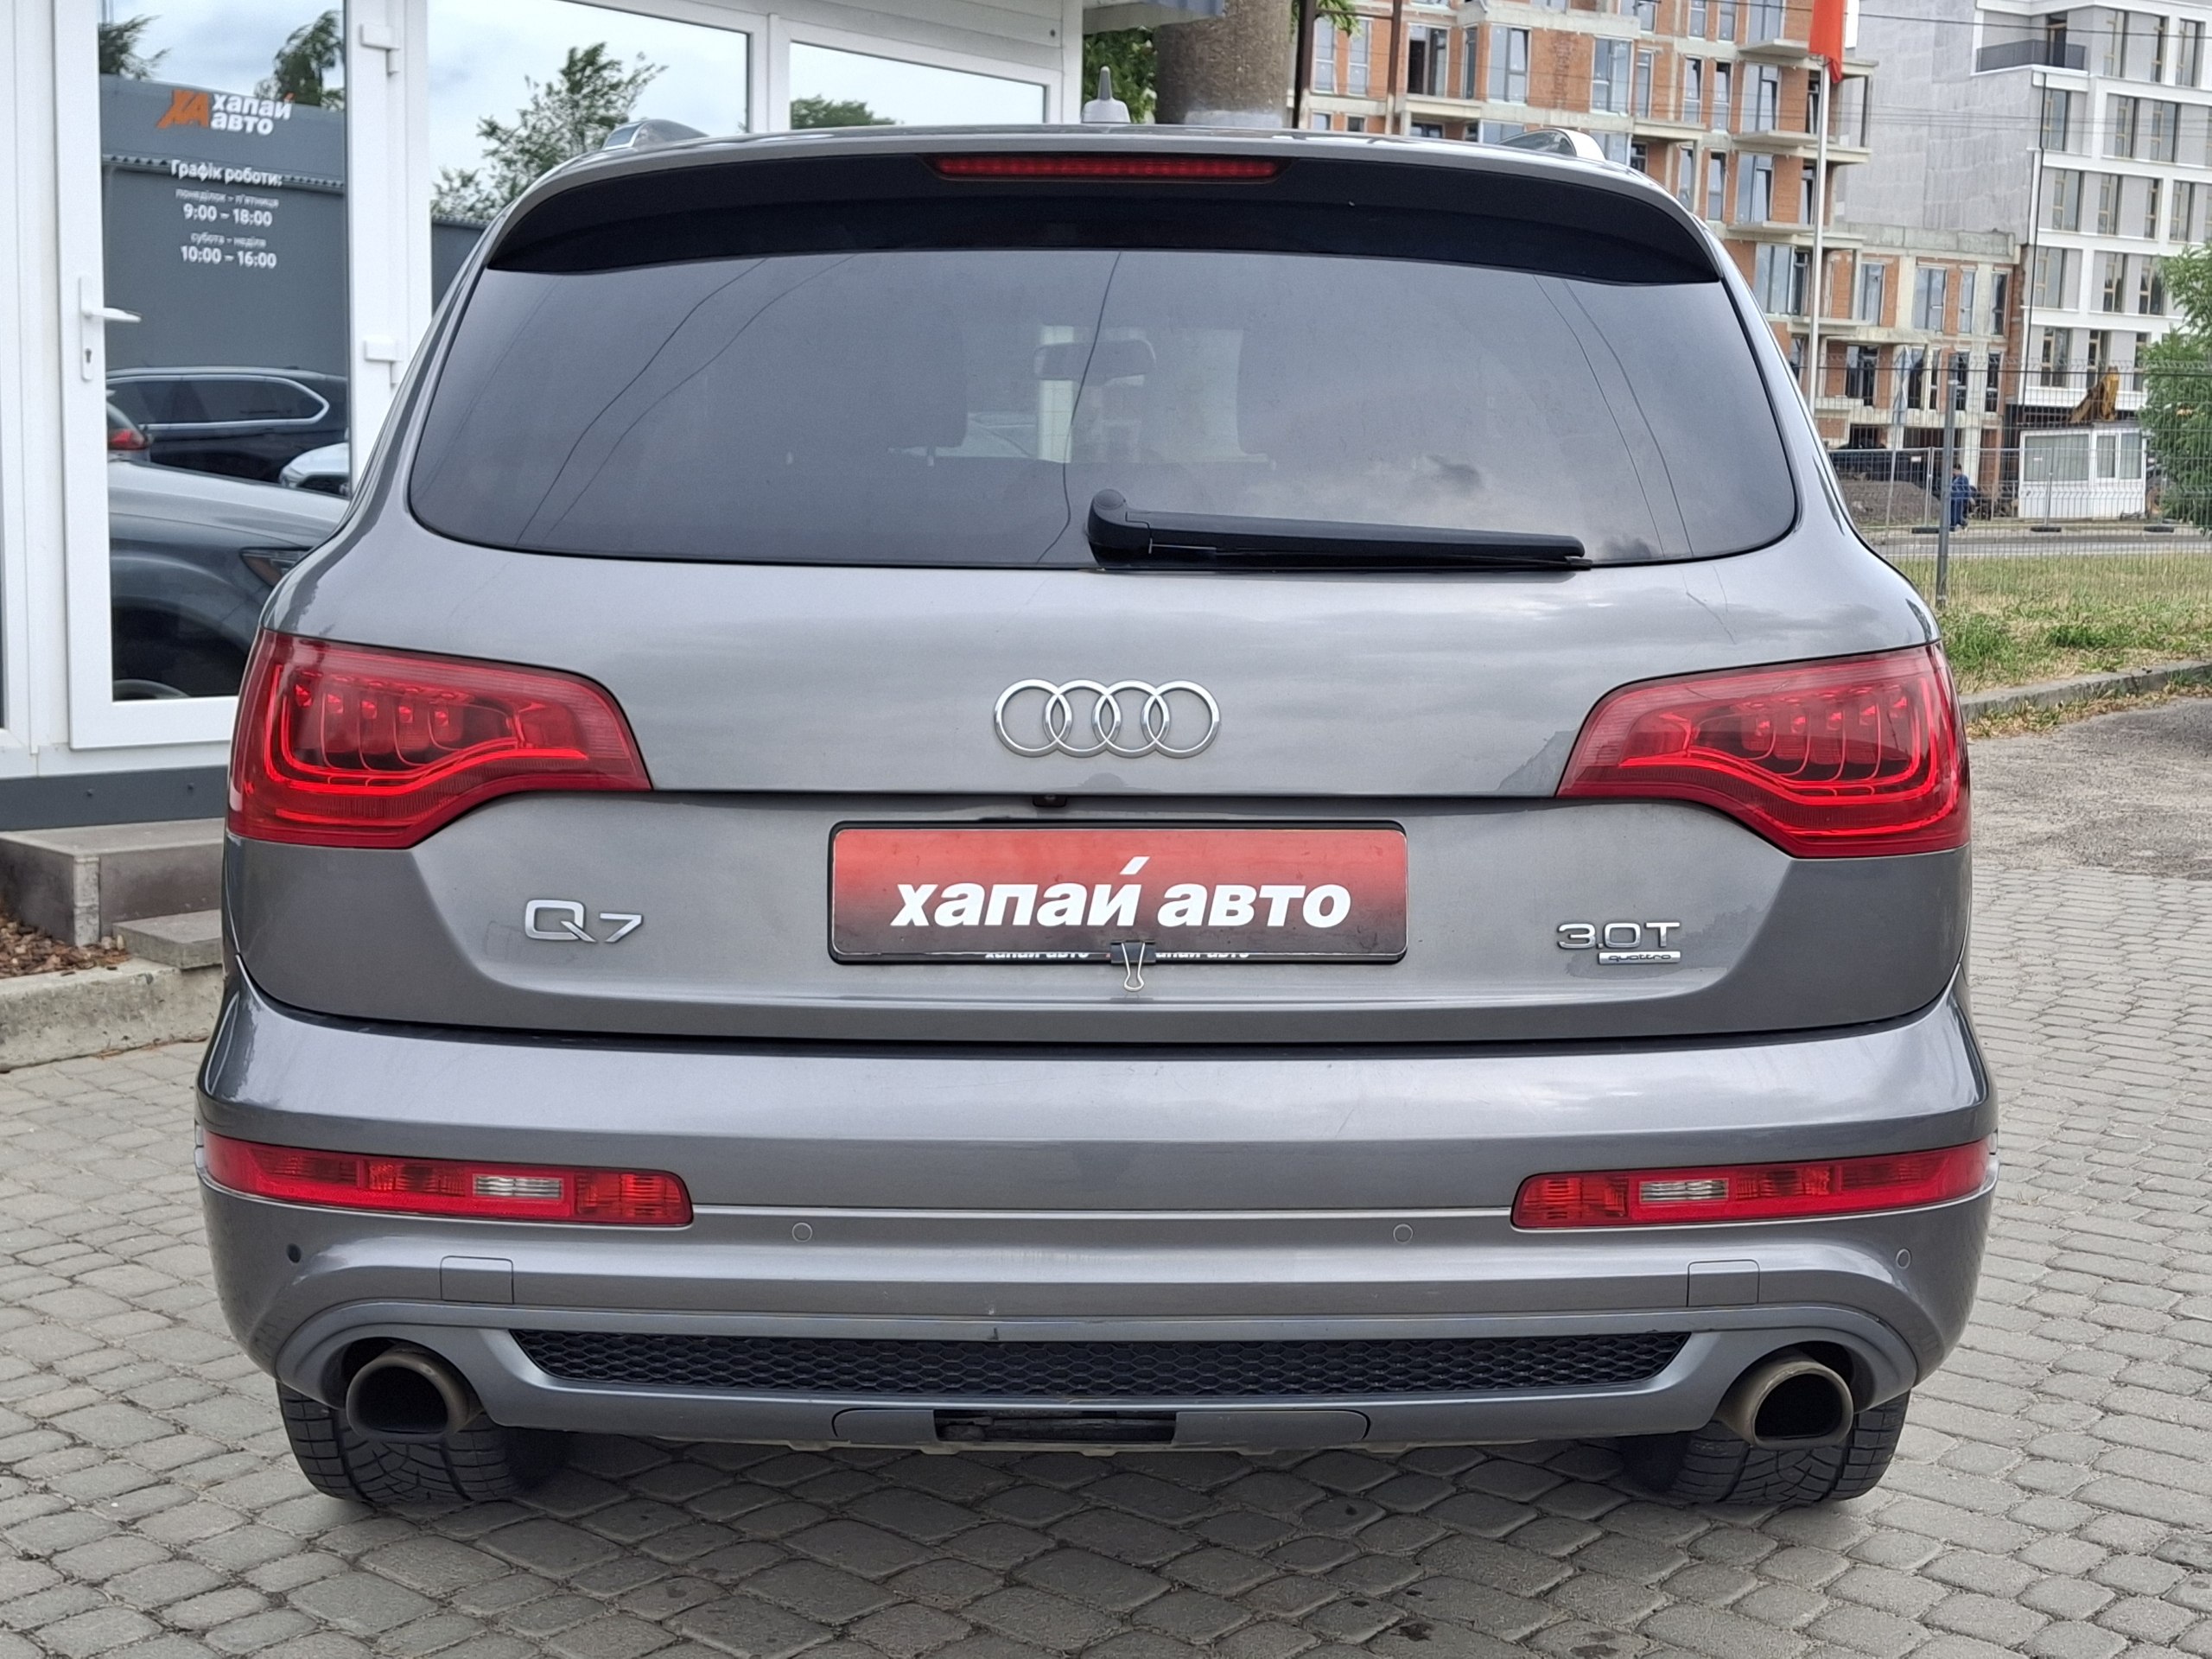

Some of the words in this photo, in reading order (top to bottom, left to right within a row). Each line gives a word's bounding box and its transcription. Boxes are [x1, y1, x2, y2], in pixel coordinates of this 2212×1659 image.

[212, 92, 294, 120] хапай
[210, 111, 274, 135] авто
[171, 159, 221, 181] Графік
[224, 167, 283, 187] роботи:
[183, 203, 218, 222] 9:00
[233, 208, 273, 227] 18:00
[181, 245, 222, 264] 10:00
[237, 251, 277, 269] 16:00
[890, 856, 1149, 927] хапай
[1157, 884, 1351, 927] авто
[1558, 921, 1681, 949] 3.0T
[1608, 953, 1672, 962] quattro
